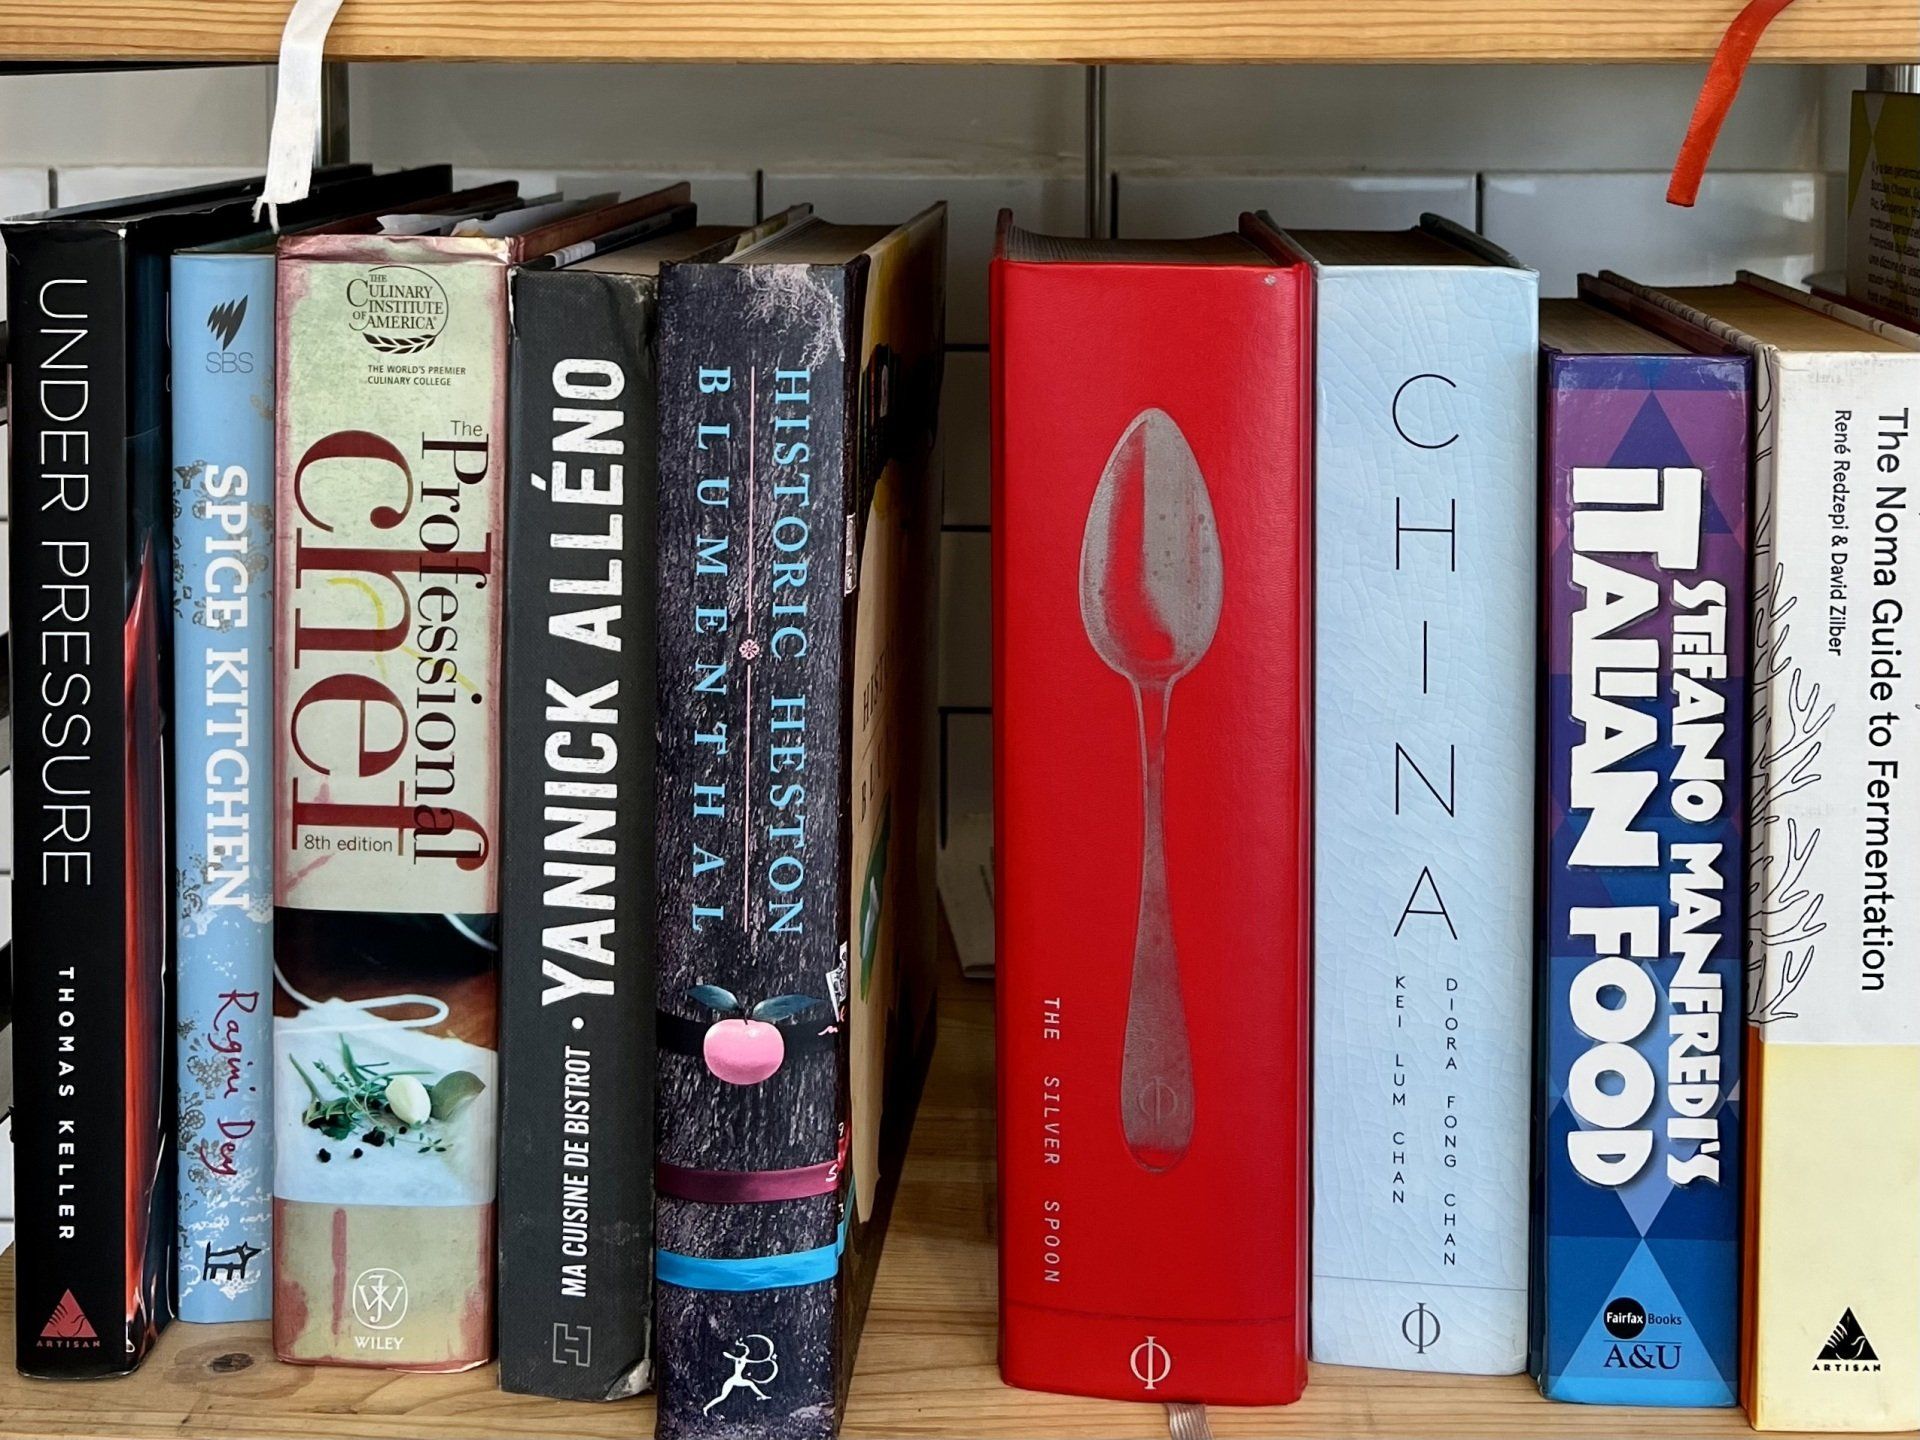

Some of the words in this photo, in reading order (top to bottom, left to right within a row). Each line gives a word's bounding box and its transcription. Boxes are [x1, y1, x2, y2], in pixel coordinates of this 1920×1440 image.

[346, 278, 434, 308] CULINARY
[368, 300, 444, 315] INSTITUTE
[369, 274, 388, 283] THE
[352, 311, 367, 320] OF
[39, 279, 89, 512] UNDER
[206, 351, 254, 374] SBS
[368, 365, 384, 374] THE
[387, 365, 426, 374] WORLD'S
[428, 367, 466, 375] PREMIER
[368, 376, 411, 385] CULINARY
[413, 378, 452, 386] COLLEGE
[450, 419, 484, 438] The
[1833, 410, 1852, 455] René
[1876, 407, 1909, 474] The
[530, 358, 625, 652] ALLÉNO
[770, 364, 811, 661] HISTORIC
[1828, 460, 1850, 530] Redzepi
[203, 463, 250, 628] SPICE
[1831, 534, 1848, 548] &
[1874, 486, 1907, 586] Noma
[1829, 552, 1848, 600] David
[290, 429, 492, 871] chef
[413, 431, 490, 866] Professional
[692, 365, 733, 934] BLUMENTHAL
[1392, 373, 1460, 941] CHINA
[1566, 467, 1703, 868] ITALIAN
[1828, 605, 1847, 657] Zilber
[1869, 598, 1904, 701] Guide
[41, 541, 91, 886] PRESSURE
[1669, 579, 1727, 822] STEFANO
[1868, 711, 1900, 747] to
[205, 646, 251, 911] KITCHEN
[768, 694, 810, 934] HESTON
[303, 835, 331, 851] 8th
[337, 836, 394, 852] edition
[541, 678, 619, 1007] YANNICK
[1861, 760, 1899, 991] Fermentation
[58, 966, 76, 1097] THOMAS
[1043, 997, 1061, 1040] THE
[1395, 975, 1406, 1028] KEI
[1444, 977, 1459, 1070] DIORA
[1666, 842, 1725, 1187] MANFREDI'S
[208, 989, 260, 1099] Ragini
[1392, 1053, 1406, 1106] LUM
[1567, 905, 1660, 1187] FOOD
[564, 1045, 591, 1135] BISTROT
[1043, 1076, 1061, 1165] SILVER
[199, 1117, 256, 1176] Dey
[563, 1141, 589, 1168] DE
[1392, 1131, 1406, 1204] CHAN
[1443, 1095, 1458, 1168] FONG
[58, 1120, 76, 1240] KELLER
[562, 1173, 589, 1257] CUISINE
[1043, 1200, 1061, 1283] SPOON
[1443, 1193, 1457, 1266] CHAN
[562, 1265, 588, 1298] MA
[1606, 1311, 1645, 1324] Fairfax
[1647, 1312, 1682, 1325] Books
[36, 1340, 101, 1348] ARTISAN
[354, 1336, 405, 1350] WILEY
[1603, 1343, 1682, 1370] A&U
[1812, 1363, 1882, 1372] ARTISAN
